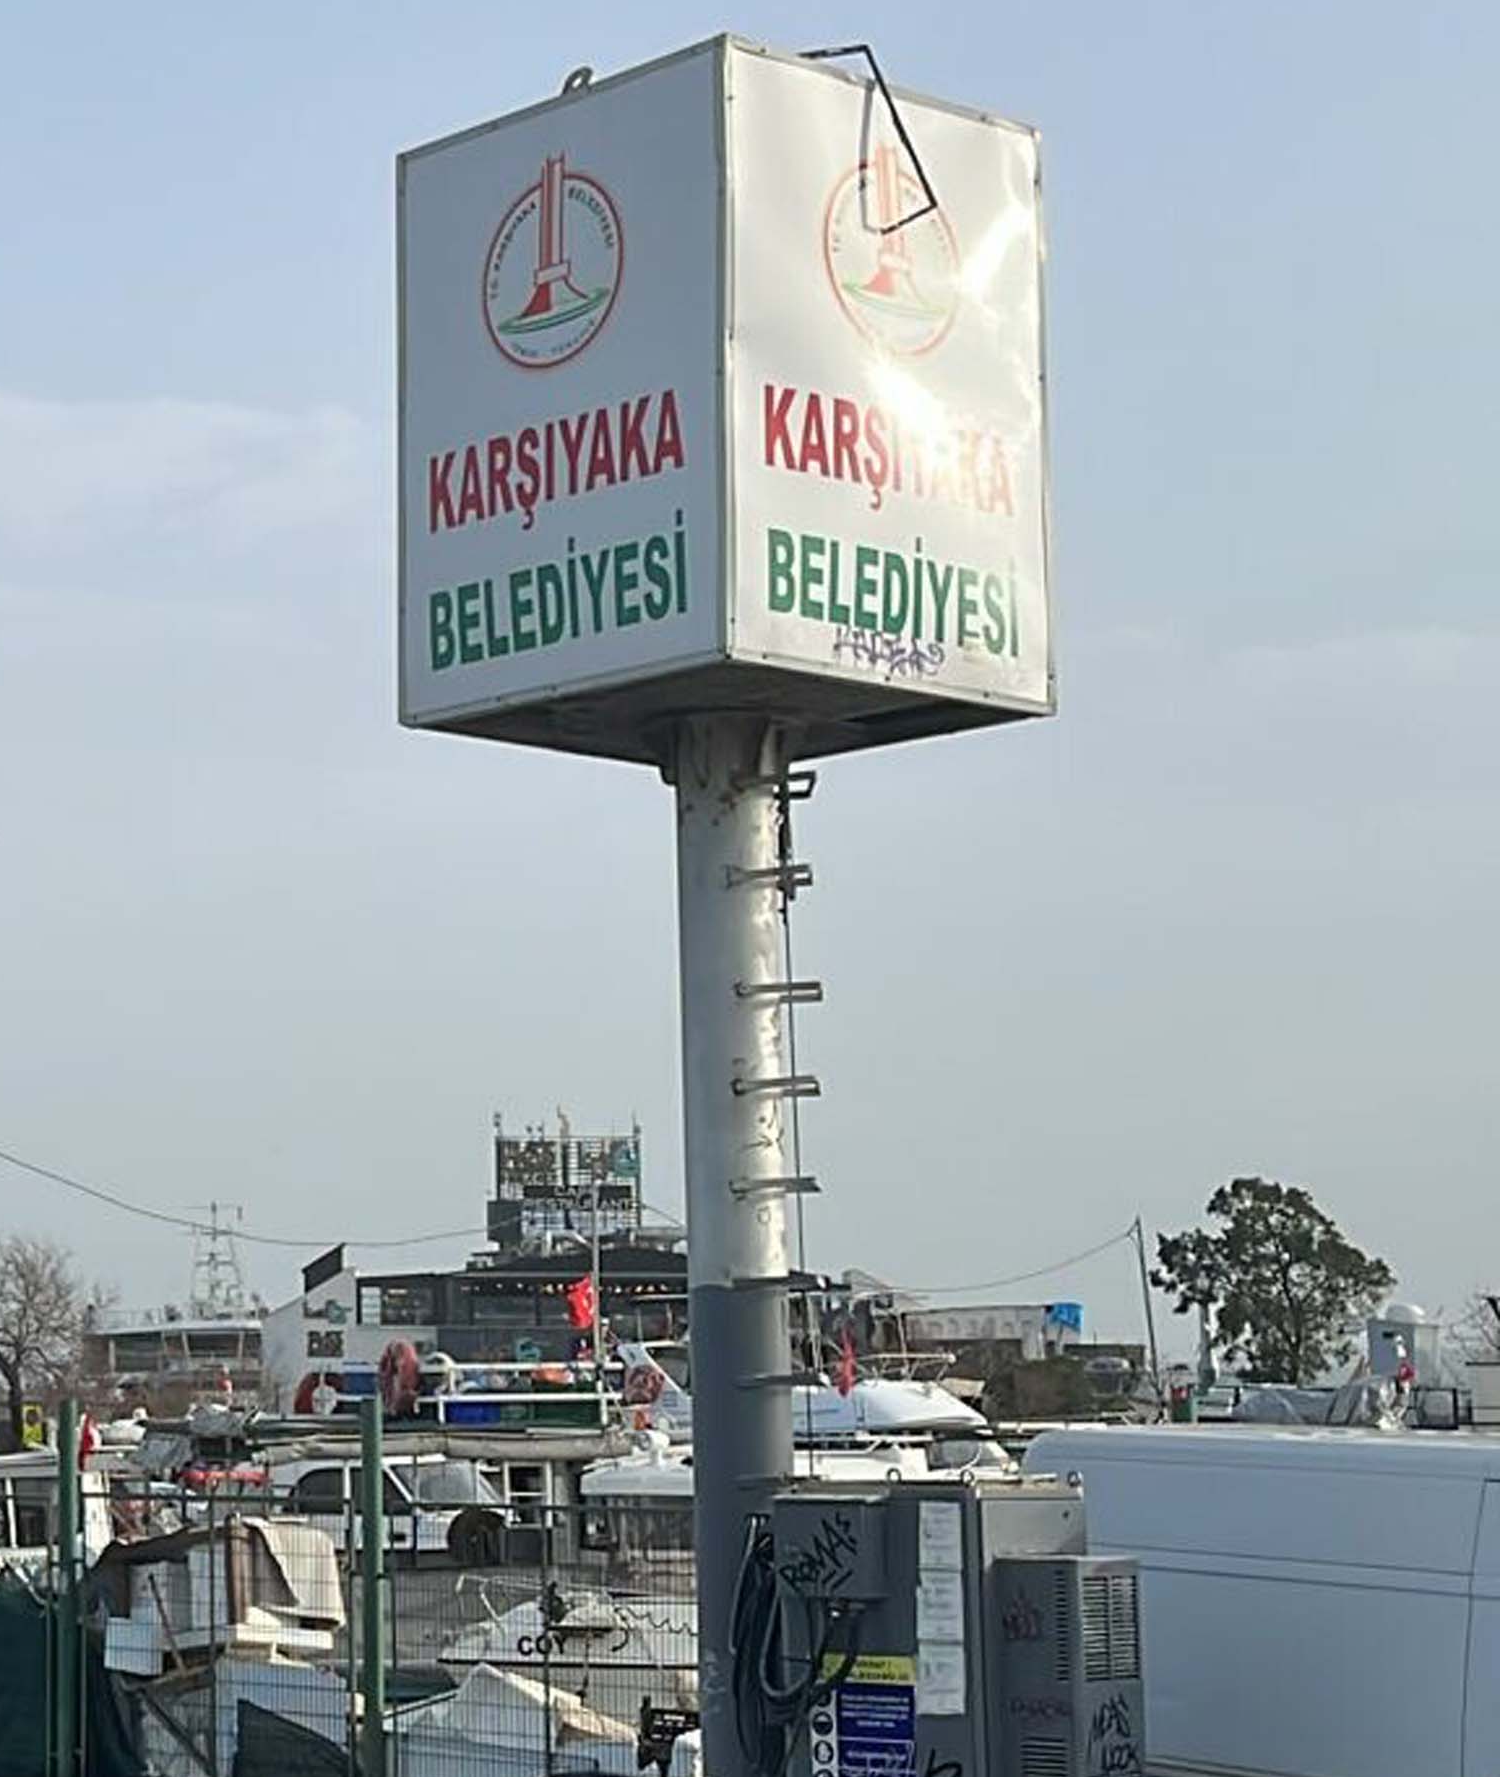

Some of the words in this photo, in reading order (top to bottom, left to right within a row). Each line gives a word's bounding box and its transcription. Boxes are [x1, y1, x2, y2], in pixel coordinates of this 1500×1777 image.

[429, 388, 685, 534] KARŞIYAKA
[764, 384, 1014, 517] KARŞIKA
[429, 508, 687, 672] BELEDİYESİ
[766, 527, 1019, 658] BELEDİYESİ
